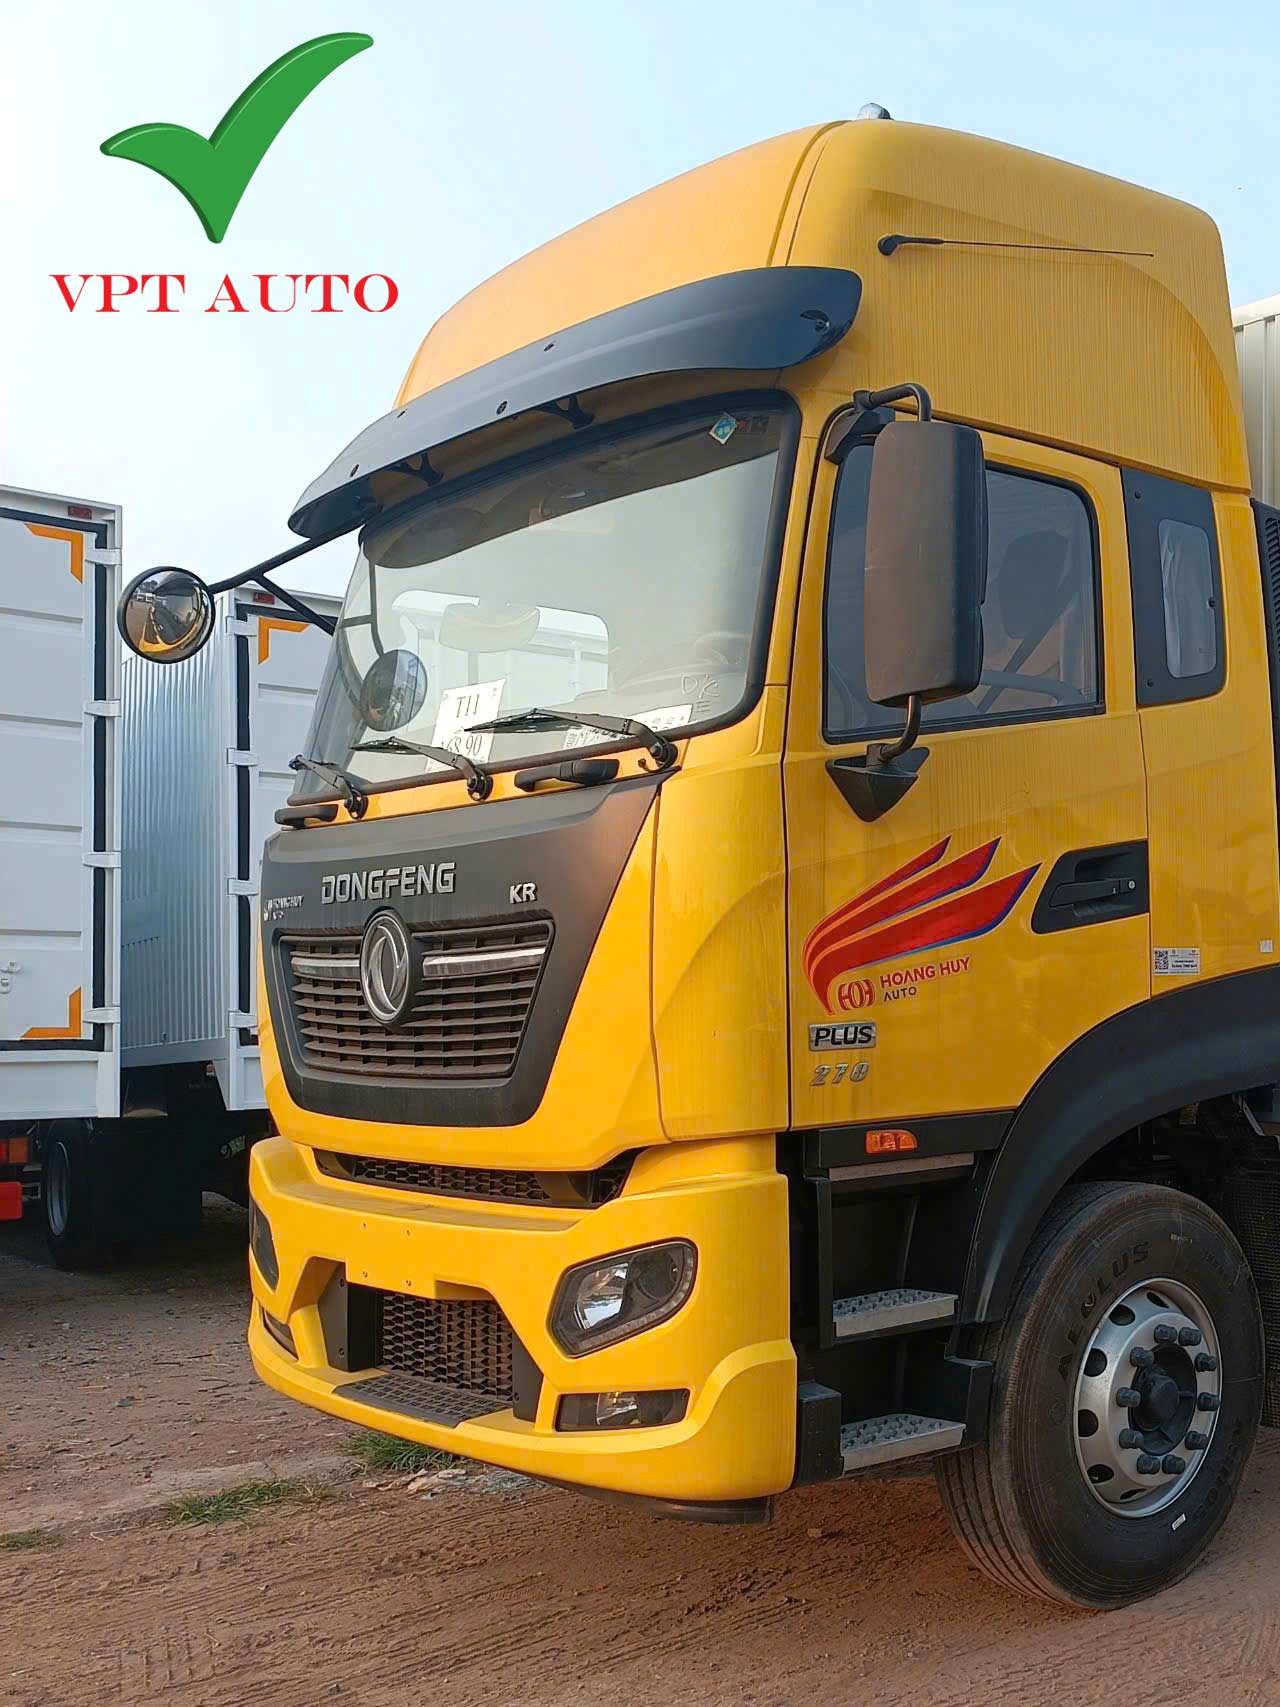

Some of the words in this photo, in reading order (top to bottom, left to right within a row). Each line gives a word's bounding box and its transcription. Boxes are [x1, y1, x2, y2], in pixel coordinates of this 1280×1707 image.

[321, 862, 456, 904] DONGFENG
[509, 882, 537, 904] KR
[880, 966, 936, 989] HOANG
[940, 957, 970, 976] HUY
[884, 986, 917, 1002] AUTO
[814, 1026, 873, 1047] PLUS
[810, 1061, 869, 1087] 270
